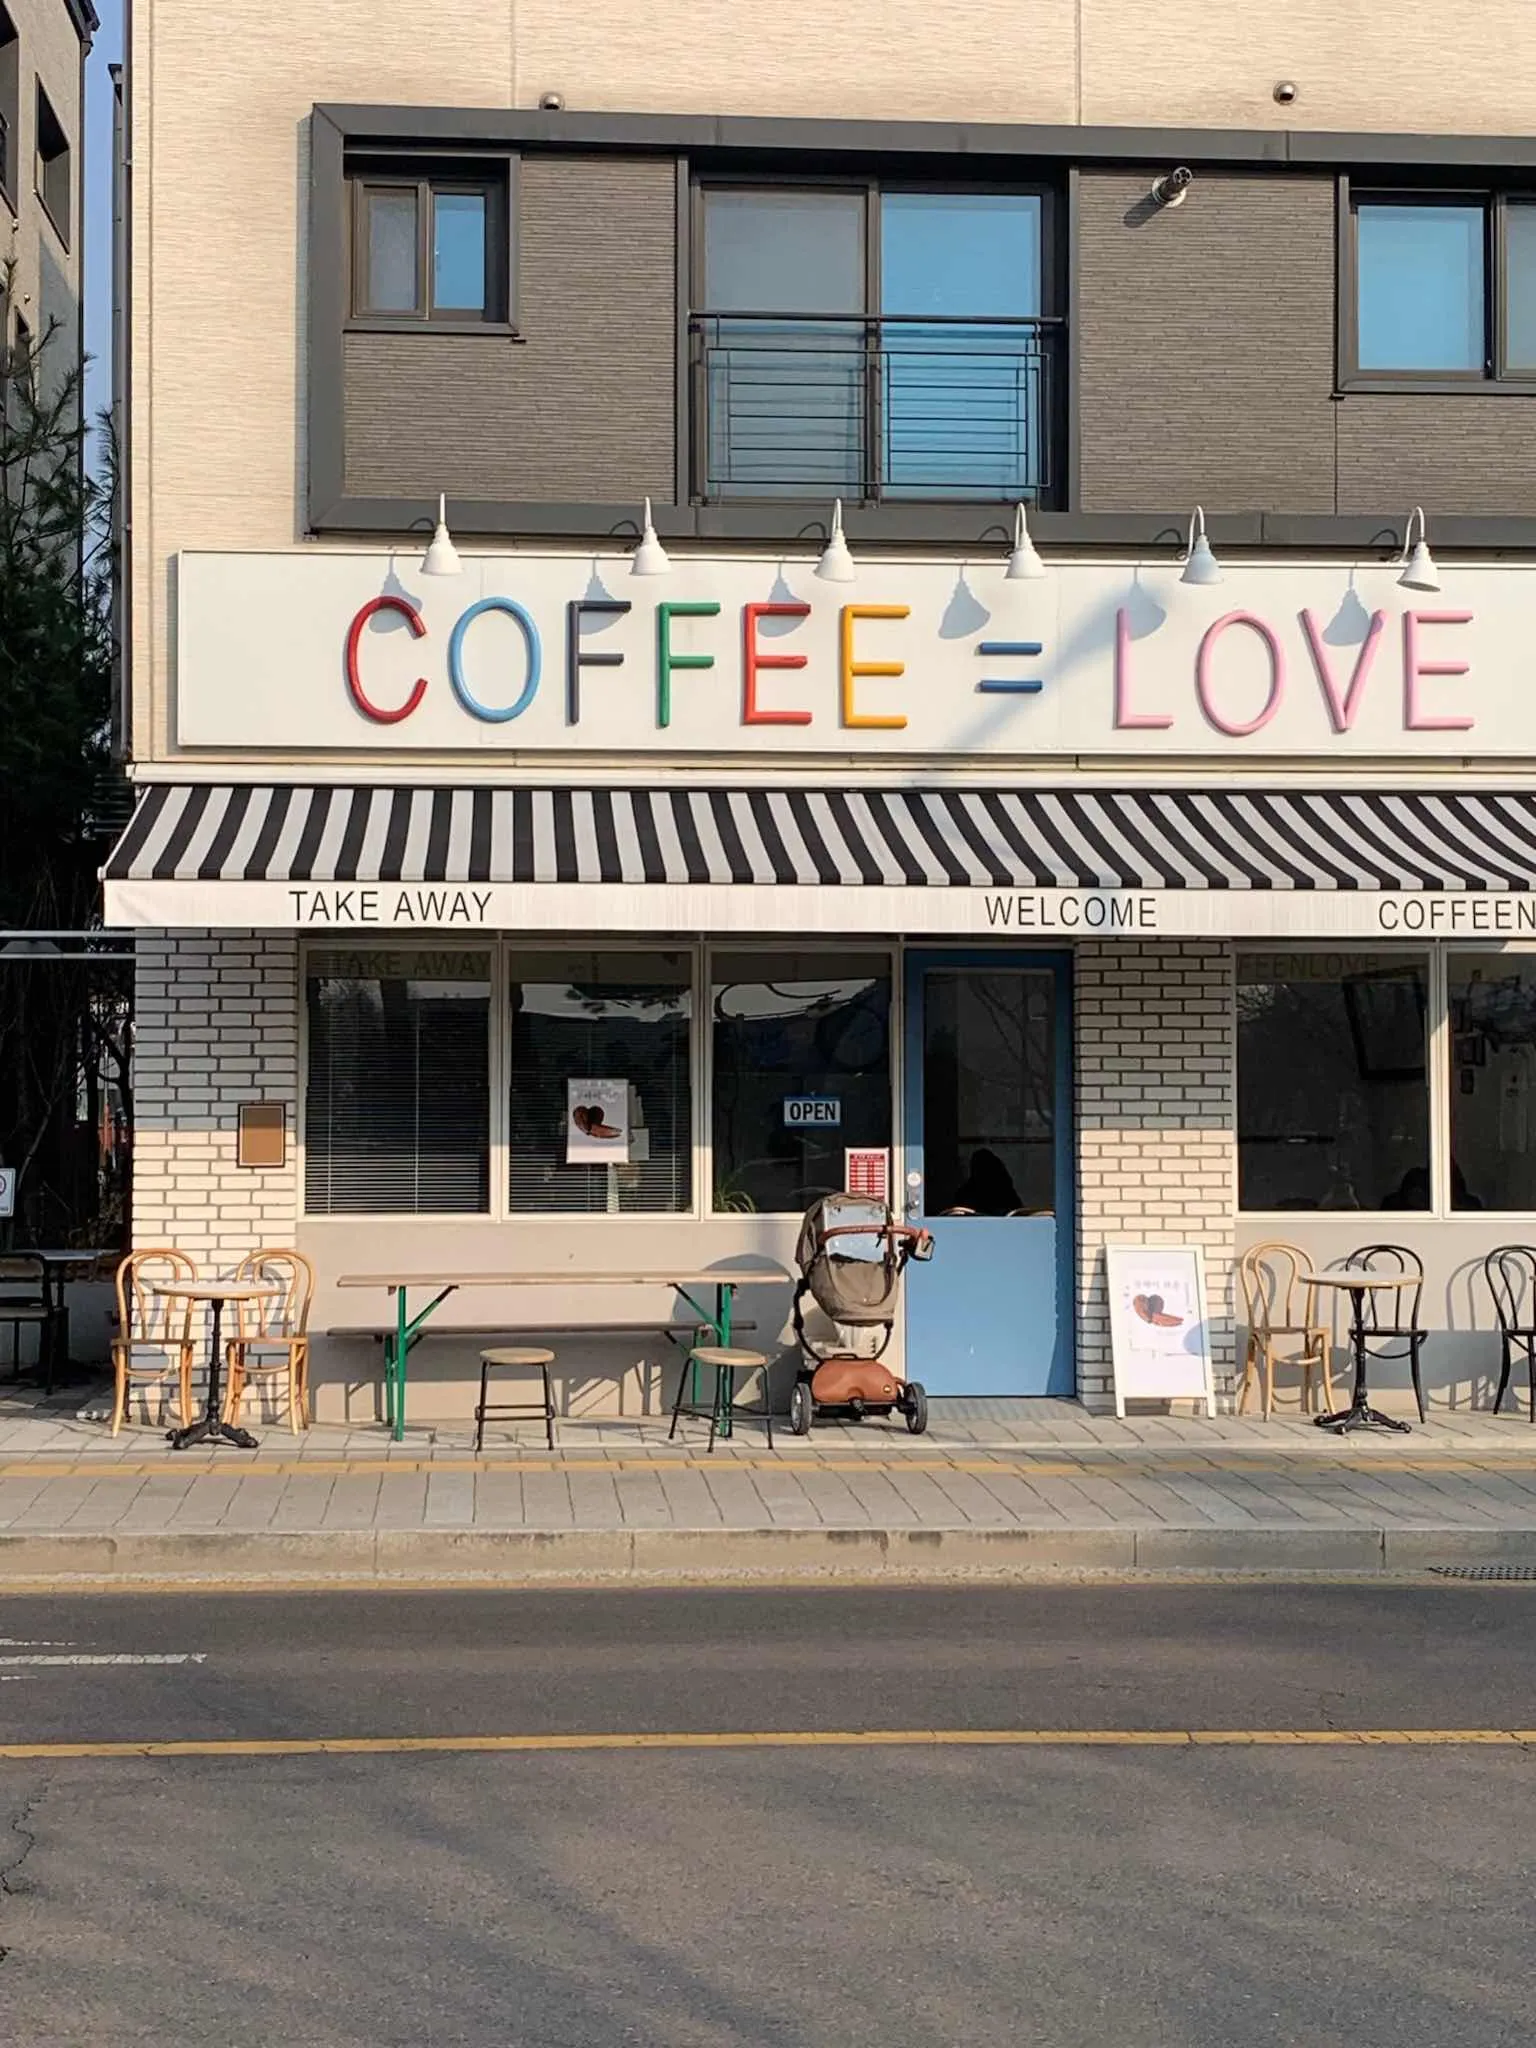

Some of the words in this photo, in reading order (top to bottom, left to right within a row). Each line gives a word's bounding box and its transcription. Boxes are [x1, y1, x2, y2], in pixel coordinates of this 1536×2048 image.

[346, 595, 909, 728] COFFEE
[979, 641, 1043, 694] =
[1115, 607, 1474, 736] LOVE
[289, 891, 378, 921] TAKE
[394, 891, 491, 921] AWAY
[986, 897, 1156, 926] WELCOME
[1379, 900, 1536, 929] COFFEEN
[789, 1102, 836, 1121] OPEN
